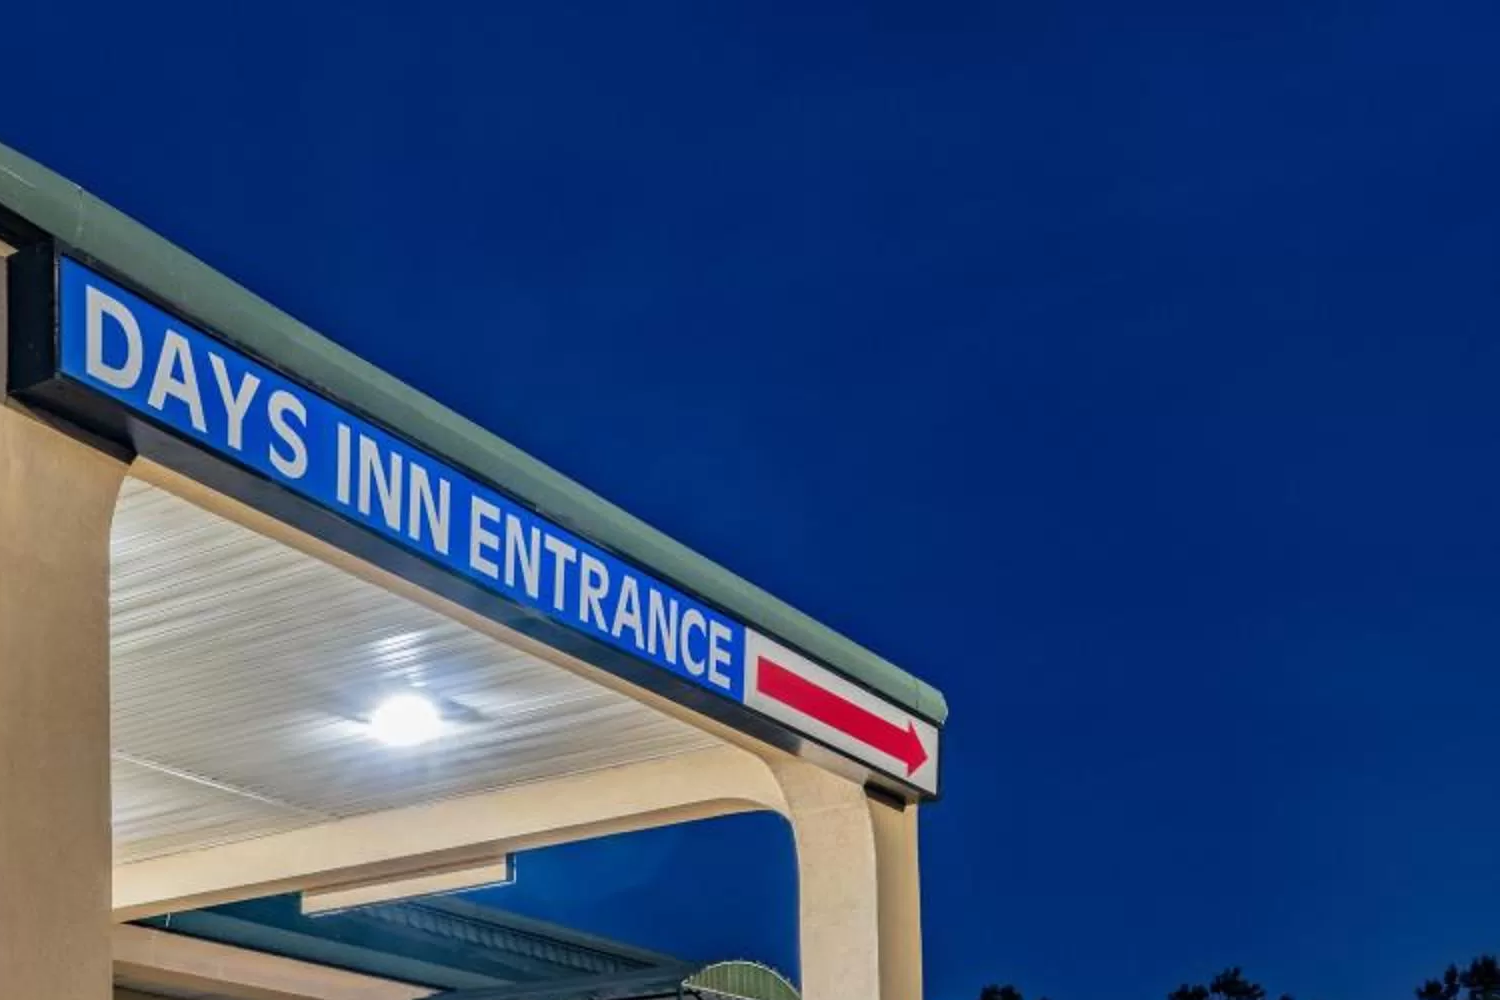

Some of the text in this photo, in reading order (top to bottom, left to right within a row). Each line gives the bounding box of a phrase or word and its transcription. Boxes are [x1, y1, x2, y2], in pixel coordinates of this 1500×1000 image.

[86, 285, 732, 690] DAYS INN ENTRANCE
